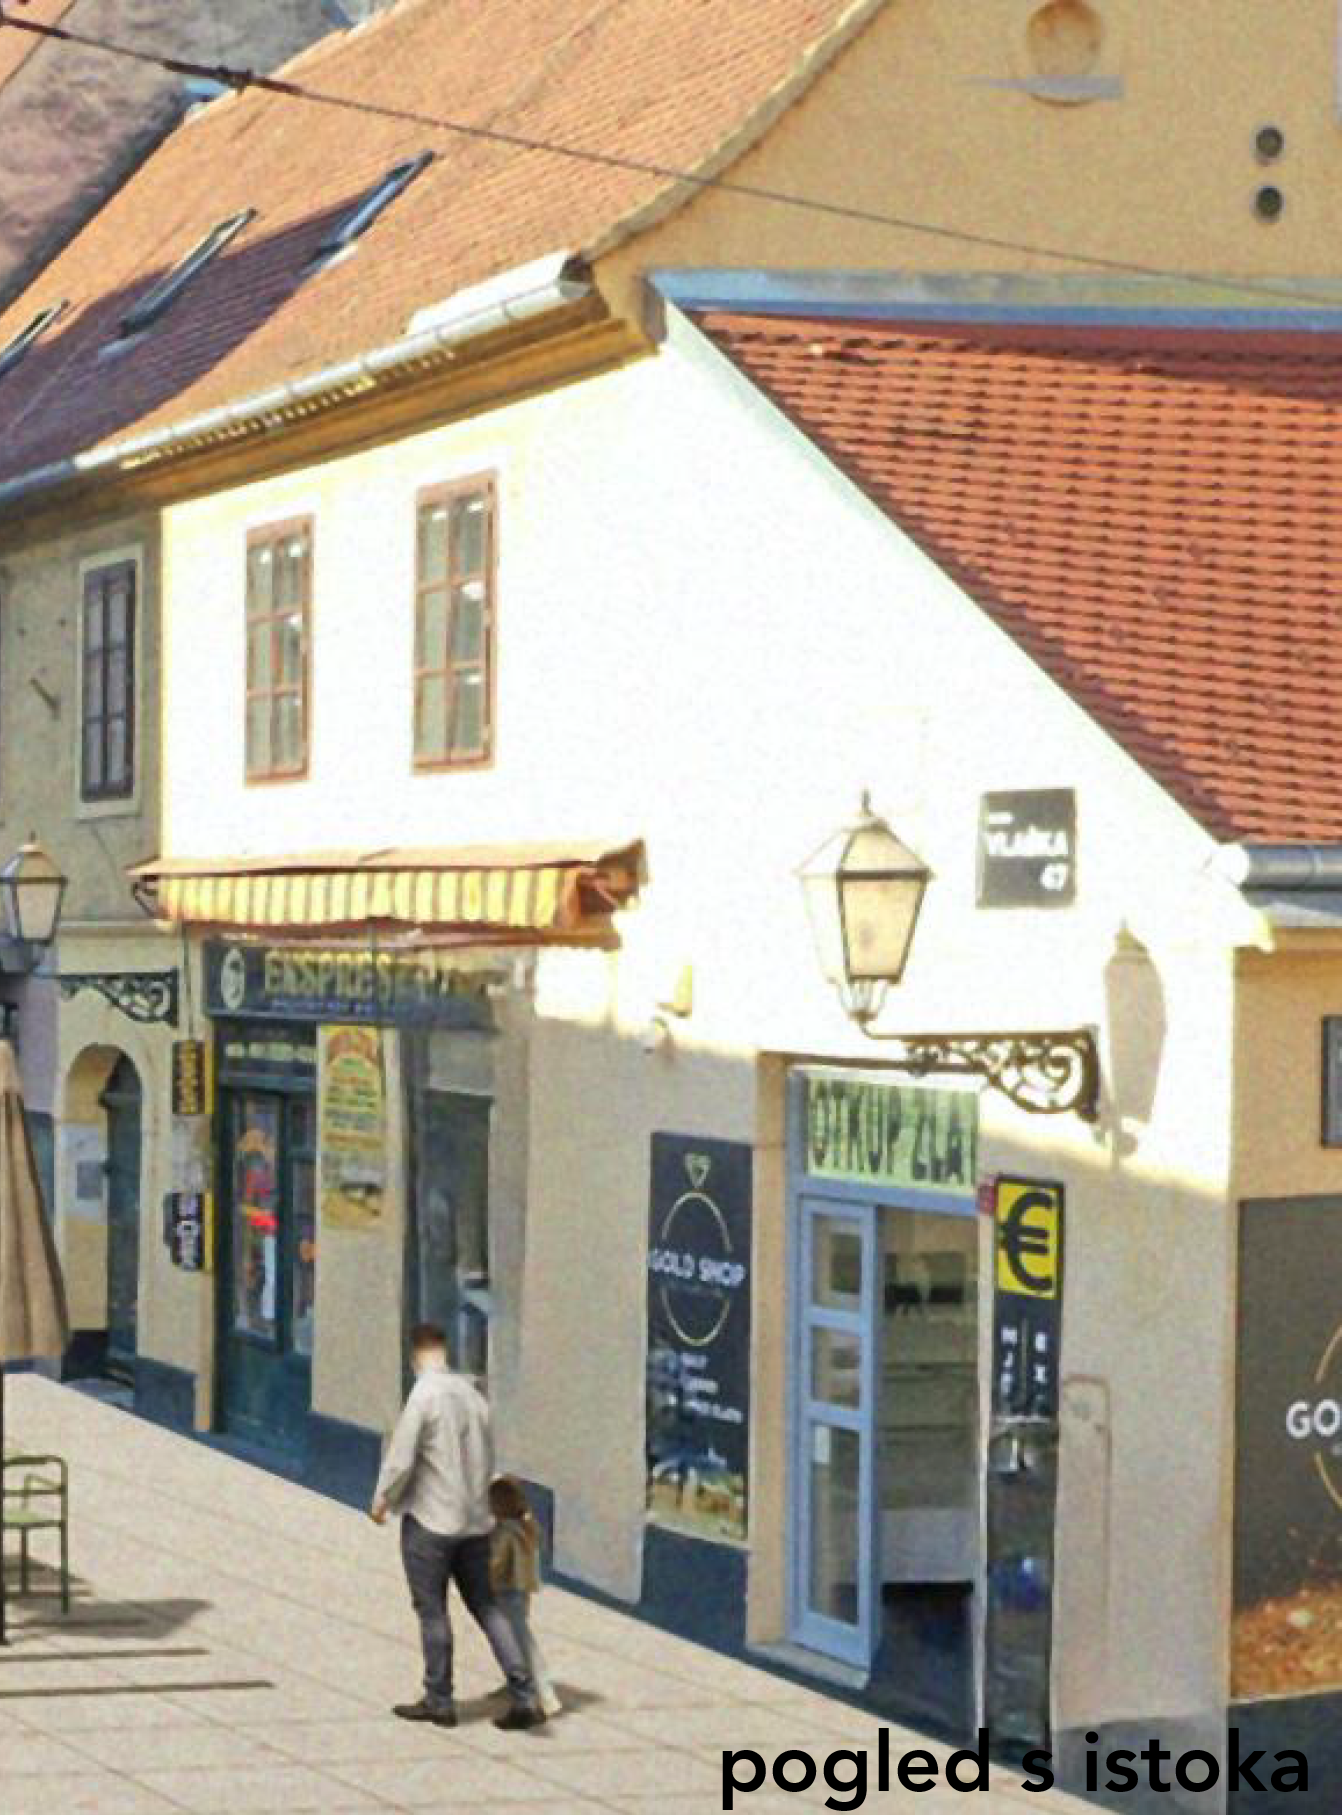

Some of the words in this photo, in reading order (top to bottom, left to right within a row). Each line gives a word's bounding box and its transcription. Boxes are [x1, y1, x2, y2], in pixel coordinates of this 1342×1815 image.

[810, 1079, 902, 1176] OTKUP
[650, 1248, 694, 1279] GOLD
[698, 1256, 745, 1288] SHOP
[1286, 1399, 1342, 1439] GO
